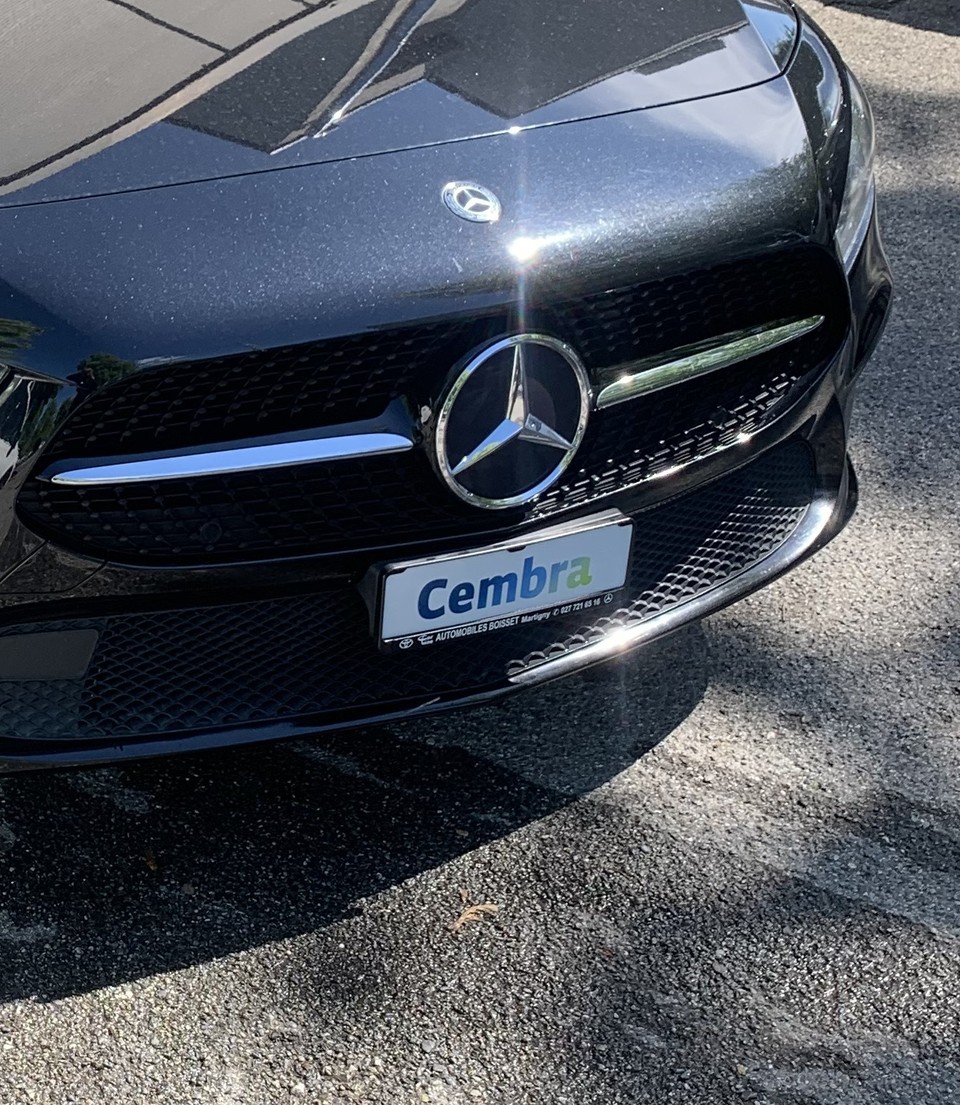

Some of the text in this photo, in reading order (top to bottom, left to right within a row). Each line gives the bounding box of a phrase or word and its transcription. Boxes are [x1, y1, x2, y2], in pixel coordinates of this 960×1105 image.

[417, 556, 593, 620] Cembra
[435, 623, 488, 642] AUTOMOBILES
[488, 616, 520, 631] BOISSET
[521, 610, 551, 624] Martigny
